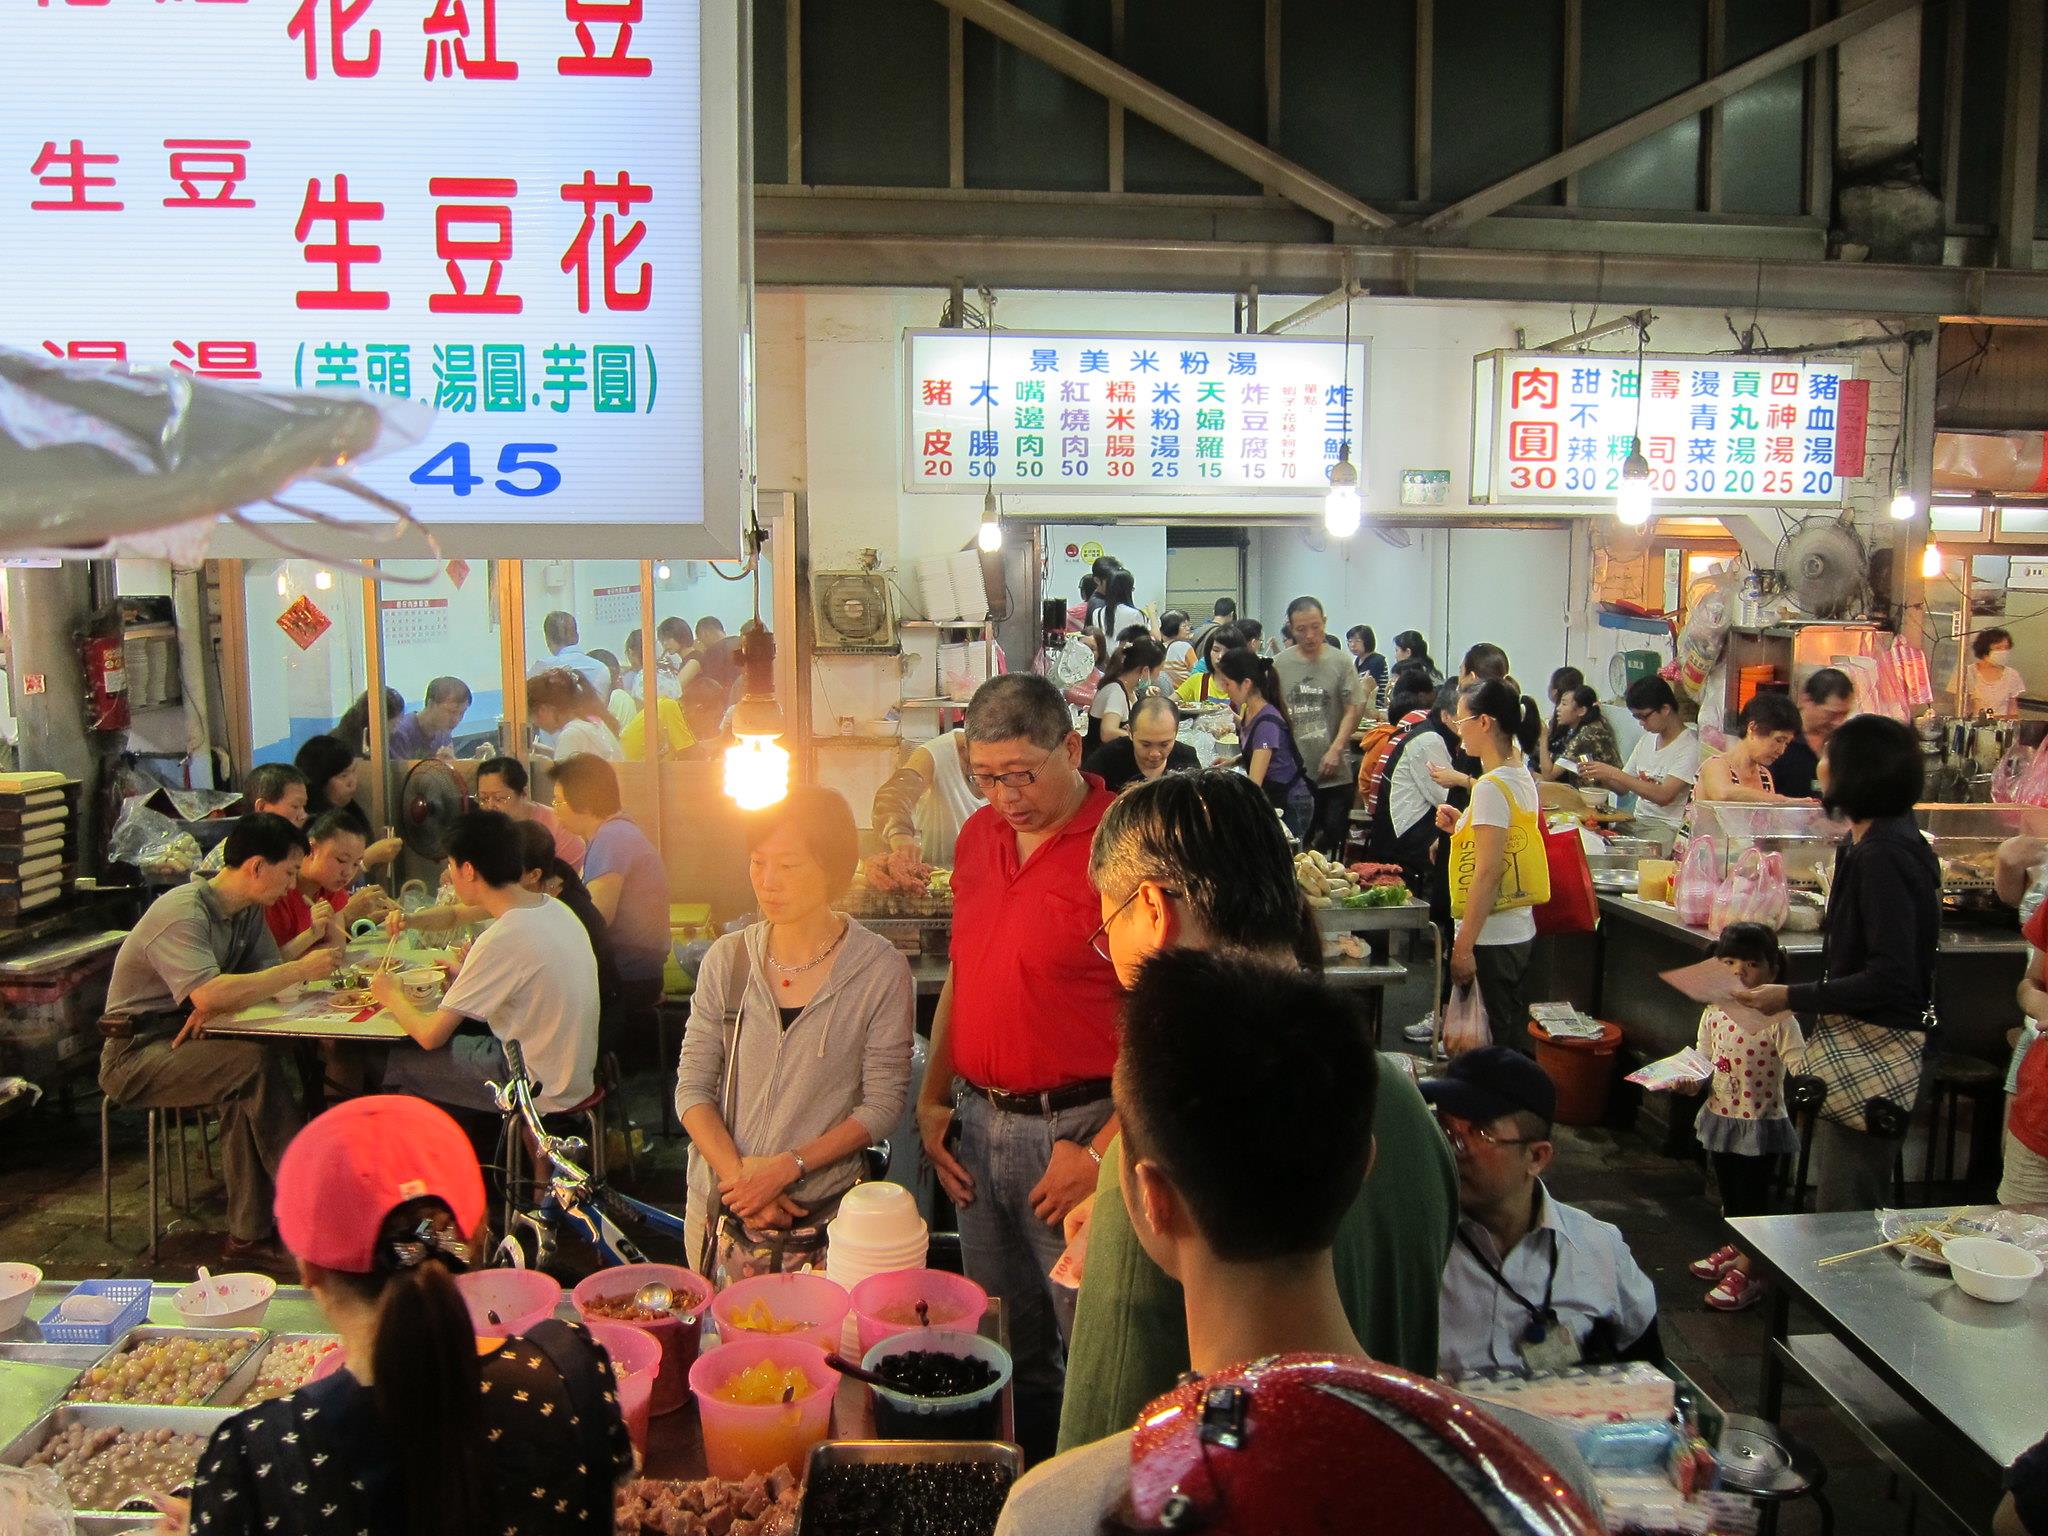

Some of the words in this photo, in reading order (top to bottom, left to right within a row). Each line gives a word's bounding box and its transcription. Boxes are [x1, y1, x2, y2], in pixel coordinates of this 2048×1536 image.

[1031, 349, 1257, 375] 景美米粉湯
[923, 379, 952, 456] 豬皮
[969, 381, 999, 458] 大腸
[1015, 381, 1044, 458] 嘴邊肉
[1061, 381, 1090, 457] 紅燒肉
[1105, 381, 1135, 457] 糯米腸
[1151, 383, 1180, 458] 米粉湯
[1195, 381, 1225, 458] 天婦羅
[1240, 383, 1269, 459] 炸豆腐
[1509, 366, 1559, 463] 肉圓
[1568, 368, 1601, 463] 甜不辣
[1606, 369, 1639, 464] 油粿
[1649, 369, 1681, 464] 壽司
[1687, 370, 1720, 465] 燙青菜
[1727, 370, 1760, 465] 貢丸湯
[1765, 371, 1801, 465] 四神湯
[1804, 373, 1838, 465] 豬血湯
[409, 442, 561, 497] 45
[924, 459, 952, 477] 20
[968, 460, 996, 478] 50
[1016, 461, 1043, 477] 50
[1061, 460, 1088, 476] 50
[1107, 461, 1135, 477] 30
[1151, 461, 1179, 477] 25
[1198, 462, 1222, 478] 15
[1242, 463, 1265, 479] 15
[1281, 463, 1296, 479] 70
[1510, 466, 1557, 490] 30
[1566, 467, 1597, 490] 30
[1648, 468, 1676, 491] 20
[1685, 470, 1715, 493] 30
[1724, 469, 1755, 493] 20
[1762, 470, 1794, 494] 25
[1803, 470, 1833, 494] 20
